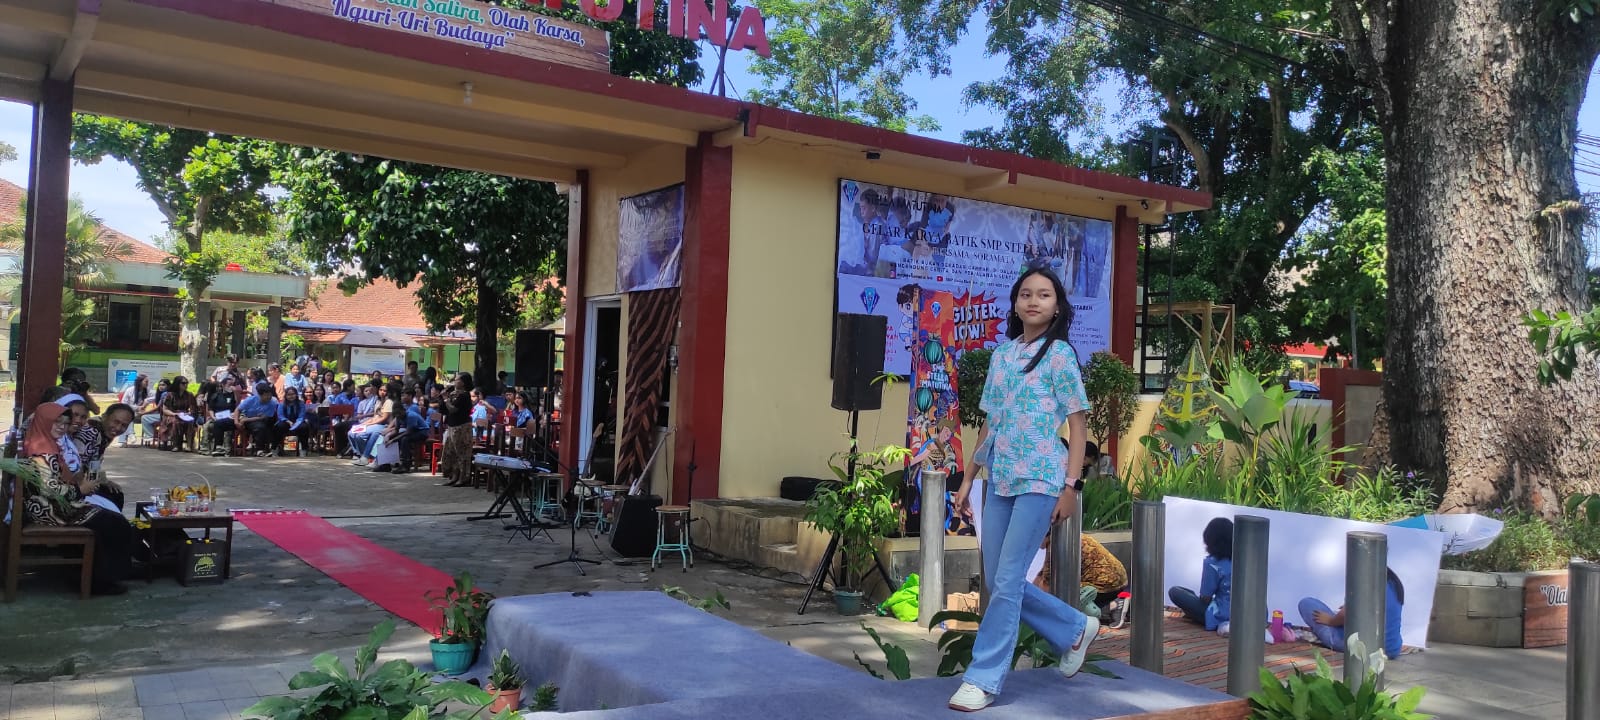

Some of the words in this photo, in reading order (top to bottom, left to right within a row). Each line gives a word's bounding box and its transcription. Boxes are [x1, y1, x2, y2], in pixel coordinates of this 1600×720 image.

[332, 0, 430, 32] Nguri-Uri
[489, 8, 529, 32] Olah
[533, 17, 584, 46] Karsa,
[862, 222, 901, 238] GELAR
[980, 238, 1002, 251] SMP
[953, 302, 999, 324] GISTER
[1540, 584, 1568, 606] "Ola
